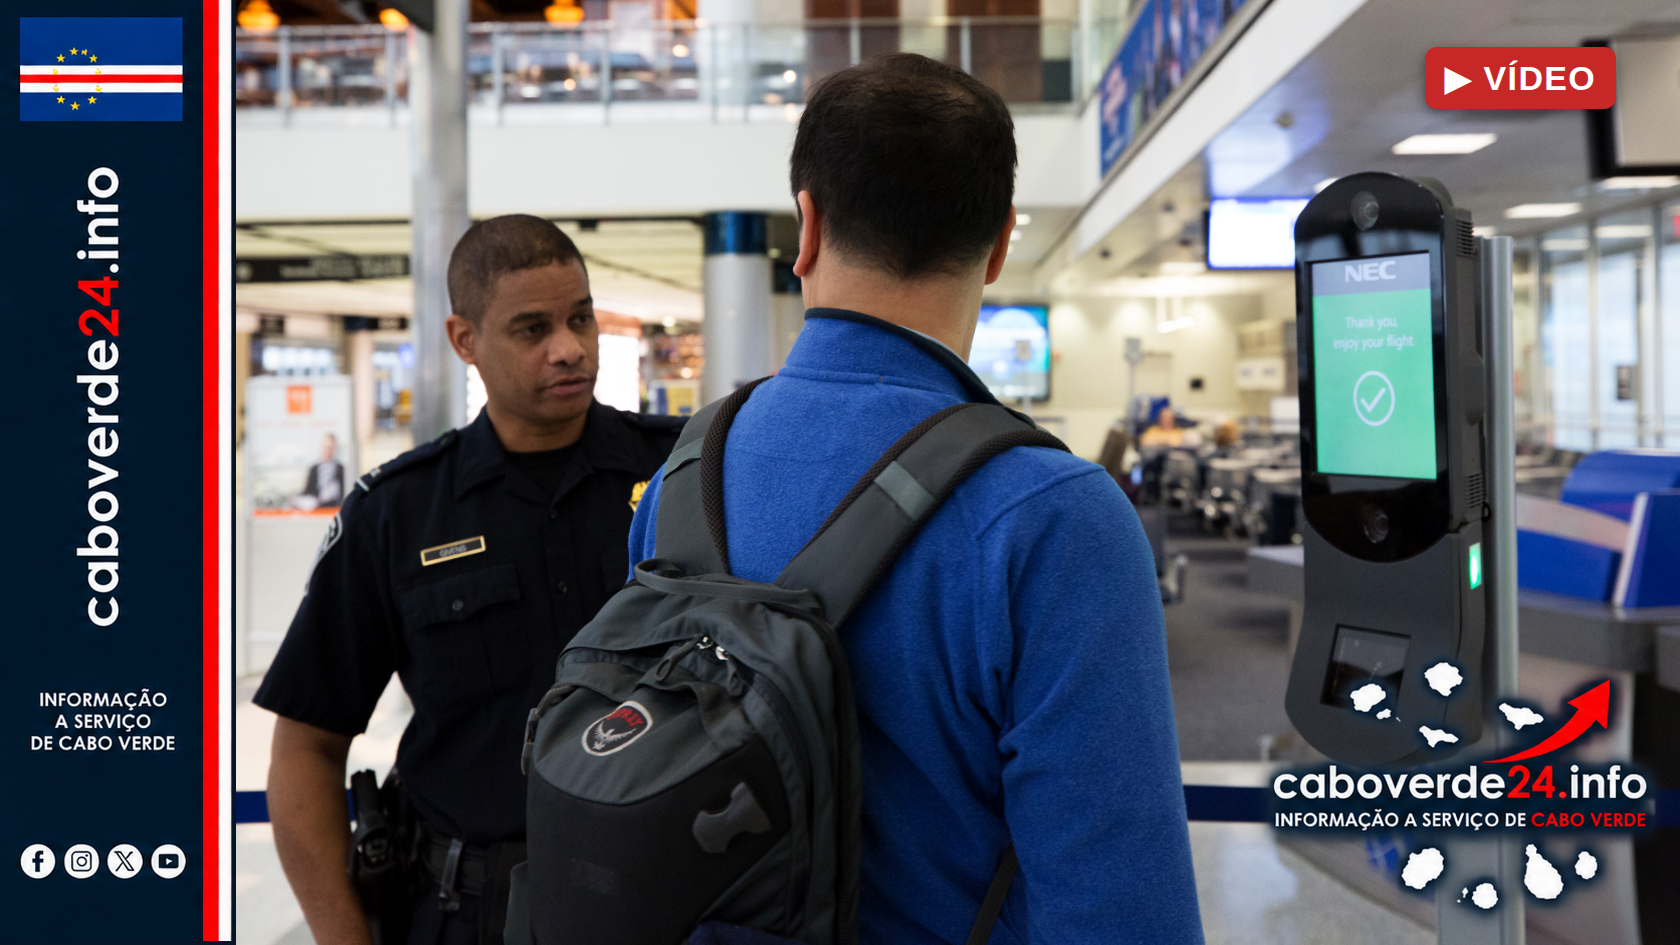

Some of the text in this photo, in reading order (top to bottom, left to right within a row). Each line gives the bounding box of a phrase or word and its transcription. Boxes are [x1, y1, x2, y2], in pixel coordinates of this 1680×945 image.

[1345, 260, 1396, 282] NEC
[1345, 316, 1399, 331] Thank you,
[1333, 334, 1414, 352] enjoy your flight
